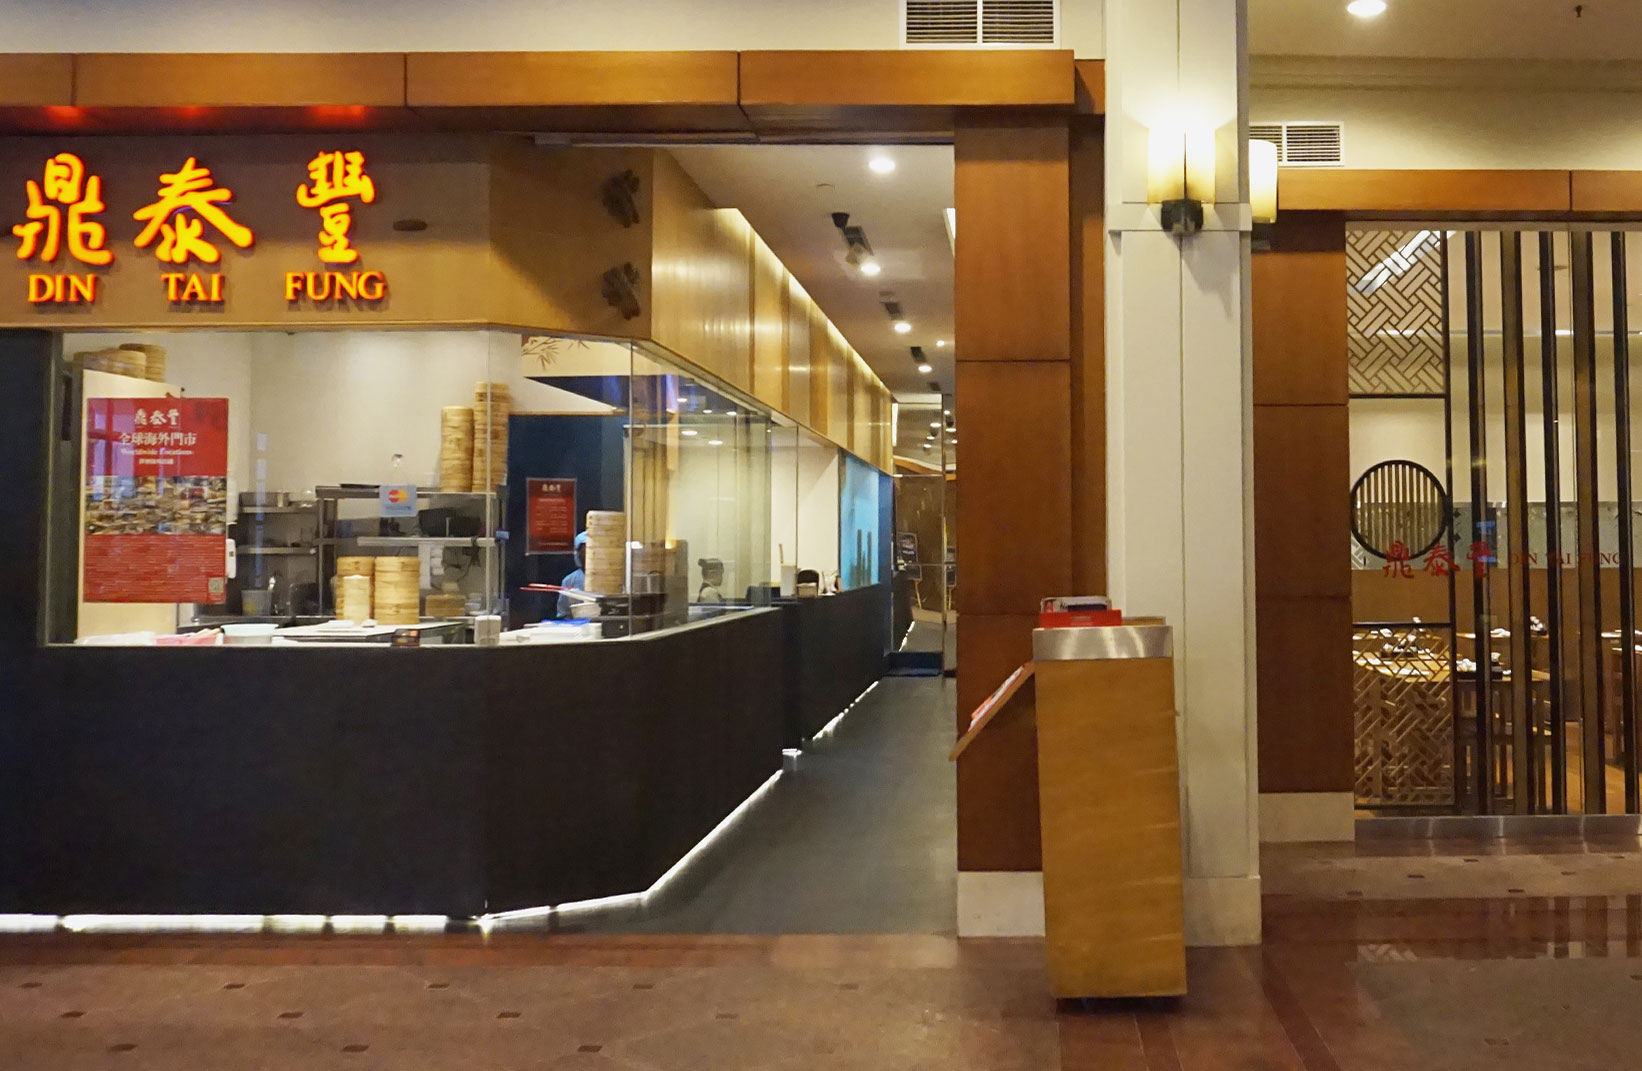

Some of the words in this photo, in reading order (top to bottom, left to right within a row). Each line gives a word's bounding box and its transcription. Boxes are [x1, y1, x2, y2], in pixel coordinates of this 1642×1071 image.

[27, 273, 98, 302] DIN
[161, 273, 225, 302] TAI
[284, 271, 385, 301] FUNG
